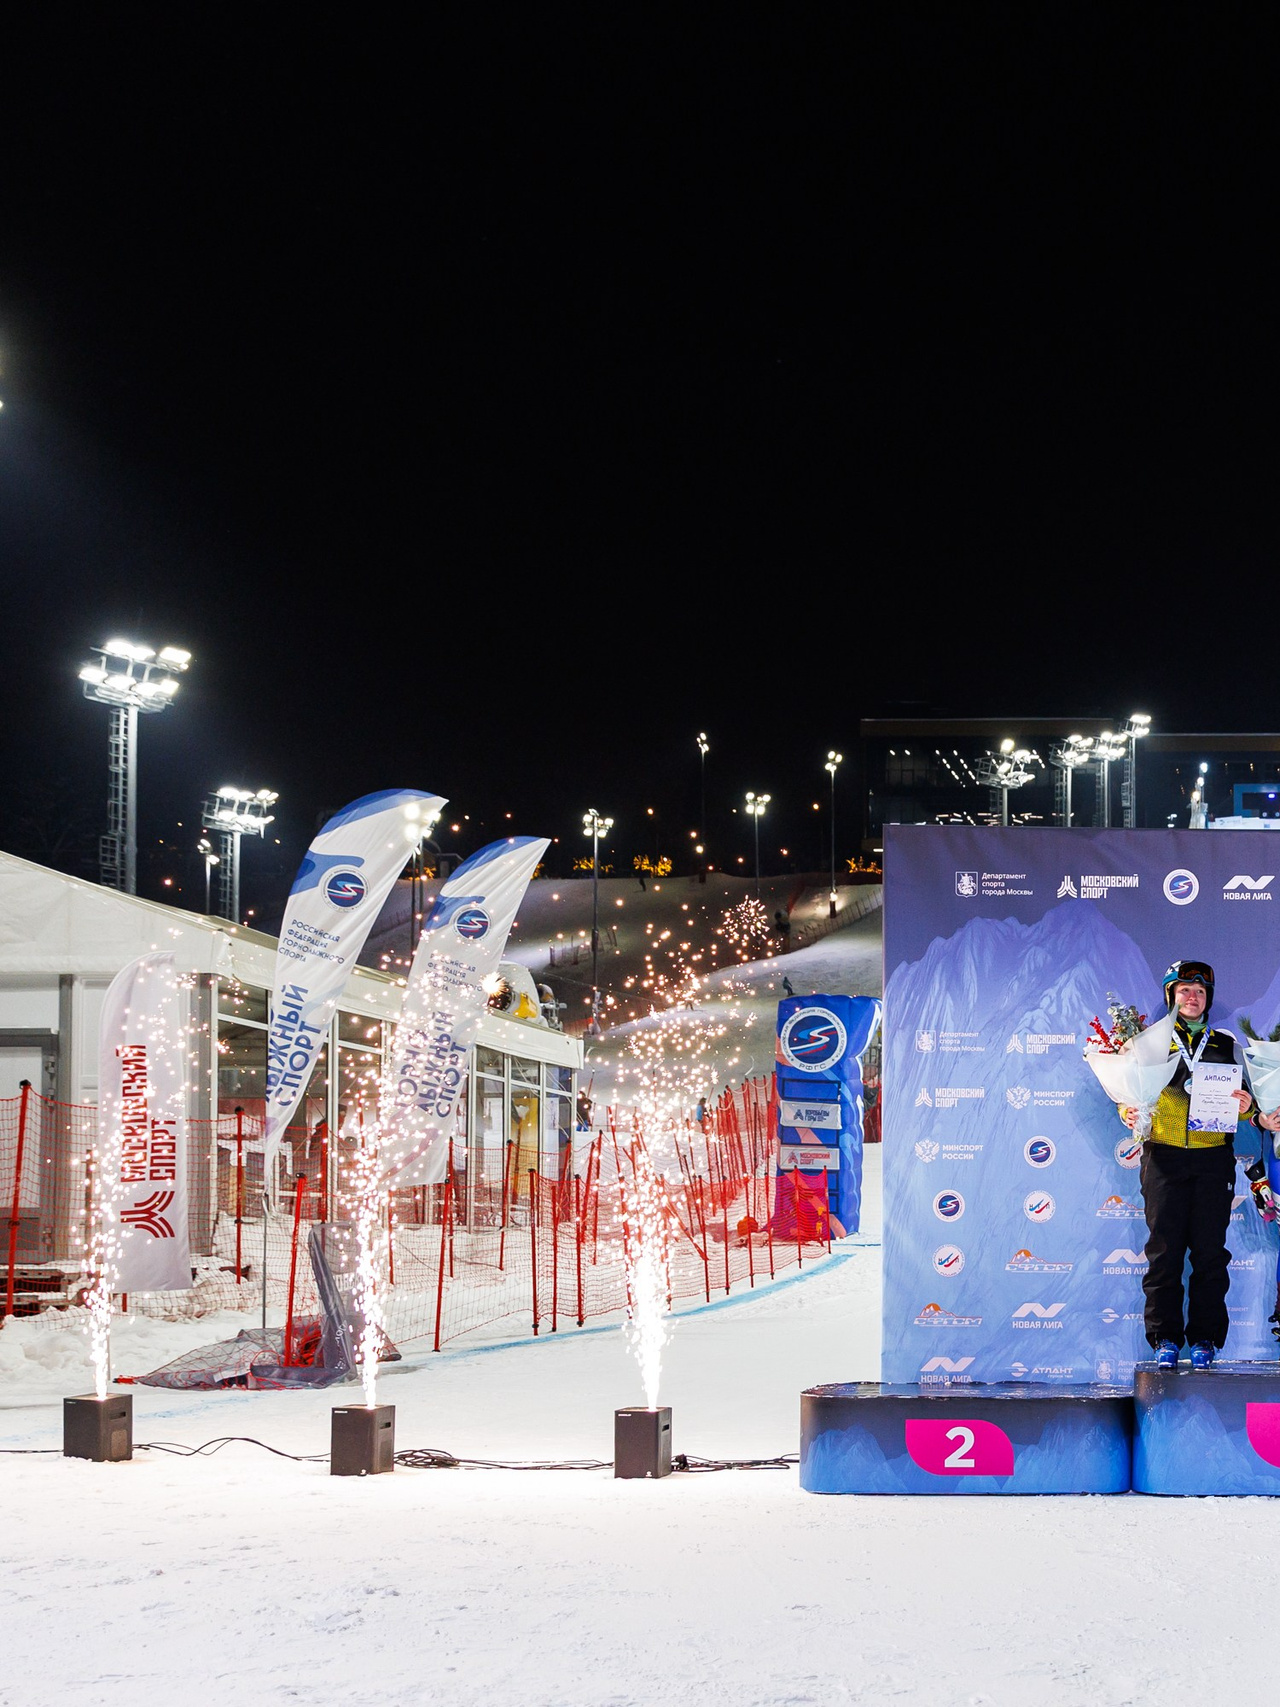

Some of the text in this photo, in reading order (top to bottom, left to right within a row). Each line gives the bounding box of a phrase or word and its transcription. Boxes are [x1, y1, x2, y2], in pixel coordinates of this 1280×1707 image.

[1081, 874, 1138, 887] МОСКОВСКИЙ
[1081, 888, 1108, 898] СПОРТ
[292, 919, 340, 942] РОССИЙСКАЯ
[287, 929, 328, 948] ФЕДЕРАЦИЯ
[278, 947, 306, 962] СПОРТА
[1027, 1033, 1075, 1044] МОСКОВСКИЙ
[1027, 1045, 1049, 1054] СПОРТ
[275, 1020, 321, 1106] СПОРТ
[436, 1042, 467, 1118] СПОРТ
[935, 1087, 984, 1098] МОСКОВСКИЙ
[935, 1098, 958, 1107] СПОРТ
[149, 1117, 176, 1181] СПОРТ
[1103, 1267, 1149, 1275] НОВАЯ ЛИГ
[921, 1375, 972, 1383] НОВАЯ ЛИГА
[944, 1426, 975, 1468] 2
